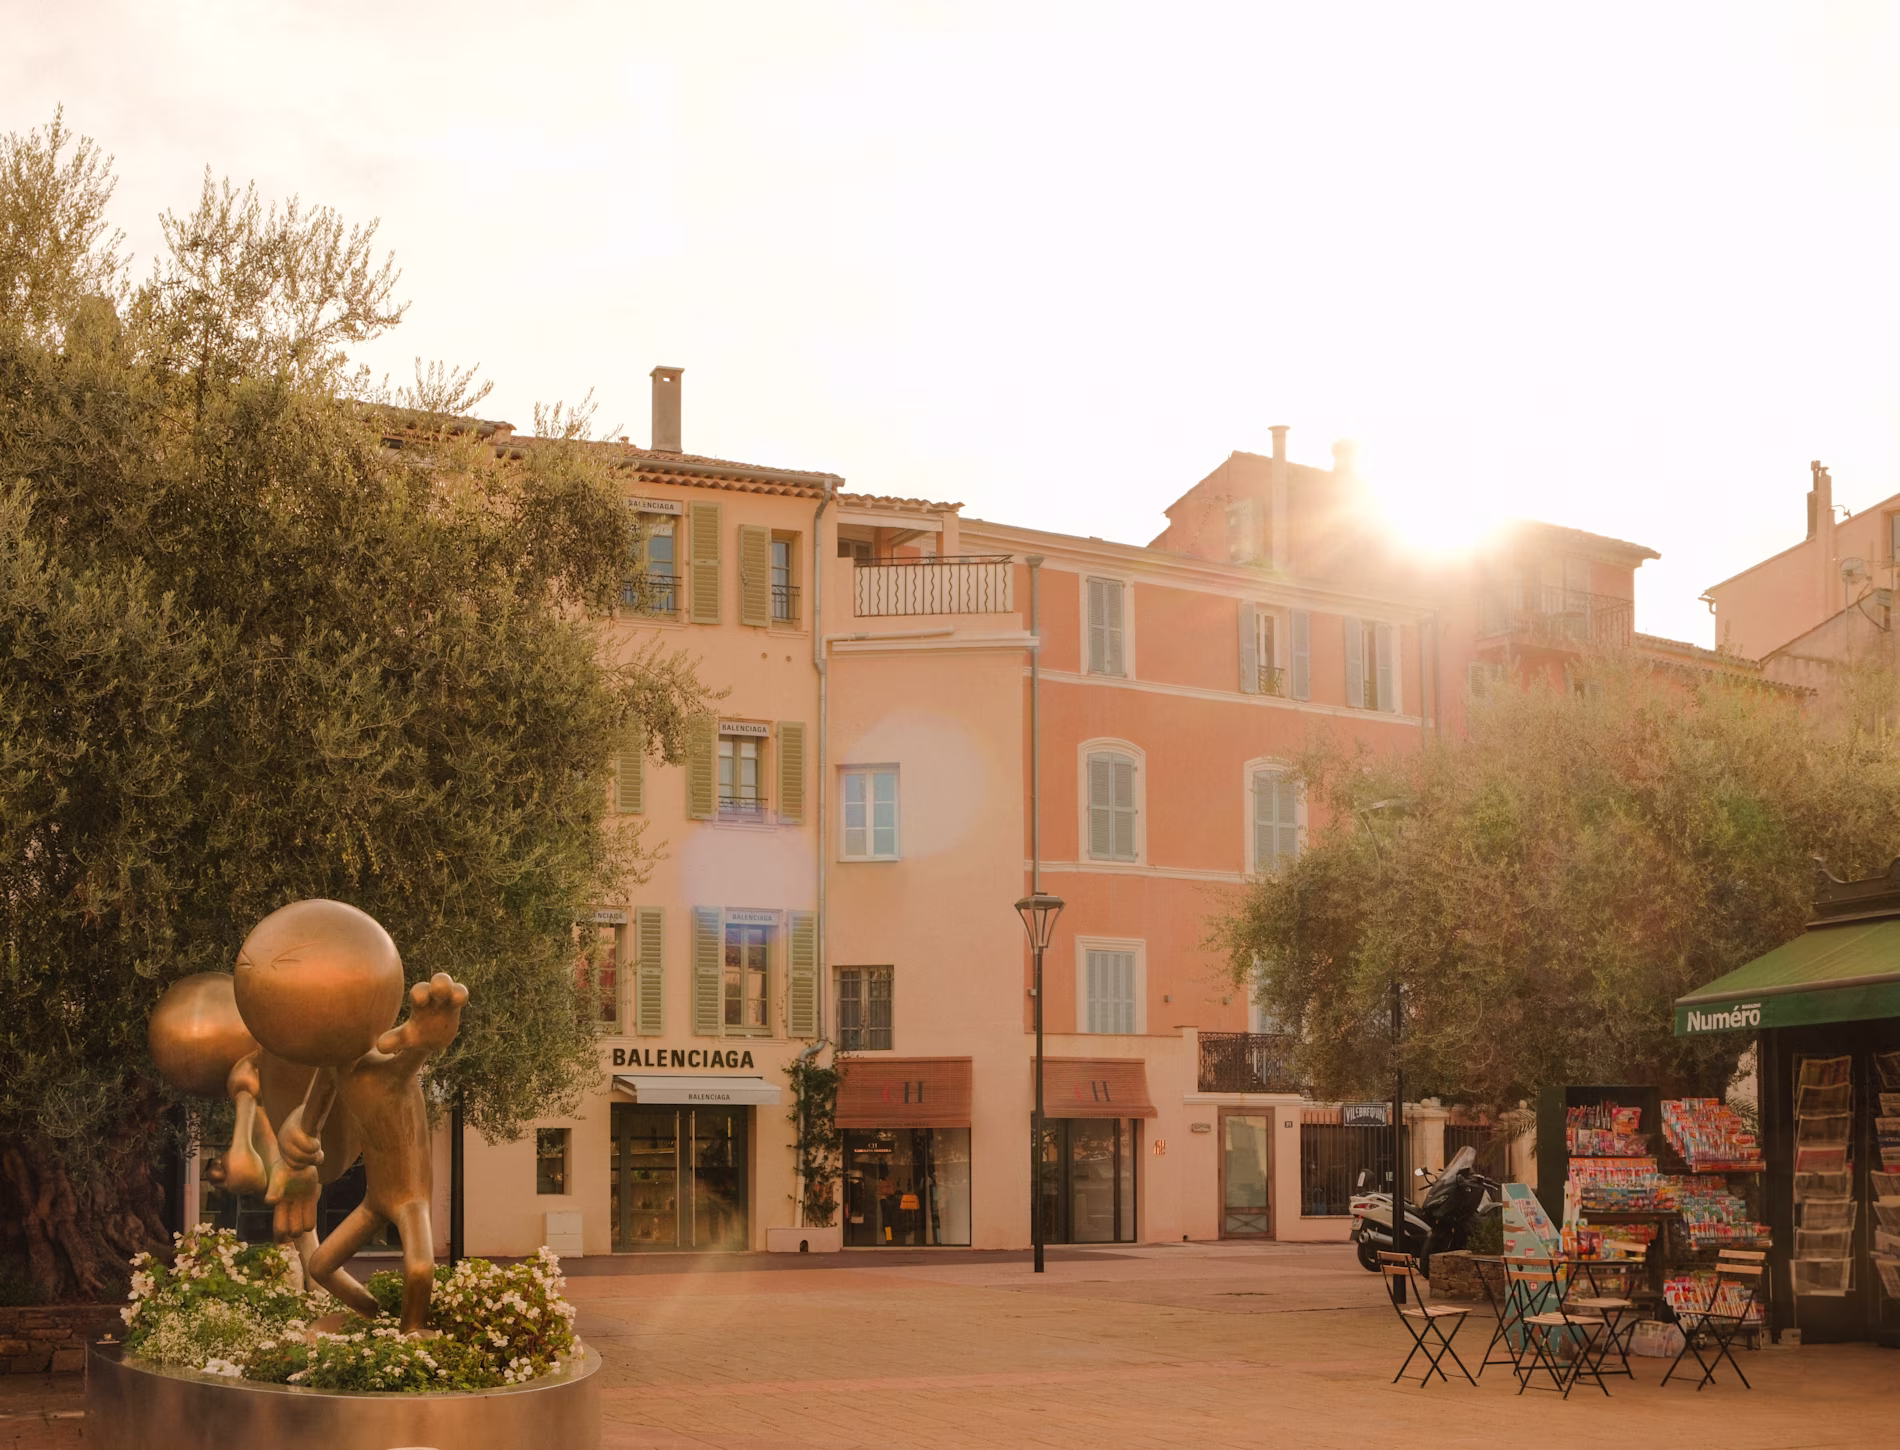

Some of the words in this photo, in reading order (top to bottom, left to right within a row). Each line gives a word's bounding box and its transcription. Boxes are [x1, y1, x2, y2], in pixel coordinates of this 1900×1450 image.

[722, 724, 767, 733] BALENCIAGA
[1687, 1005, 1760, 1032] Numéro
[613, 1048, 755, 1068] BALENCIAGA
[688, 1093, 731, 1101] BALENCIAGA
